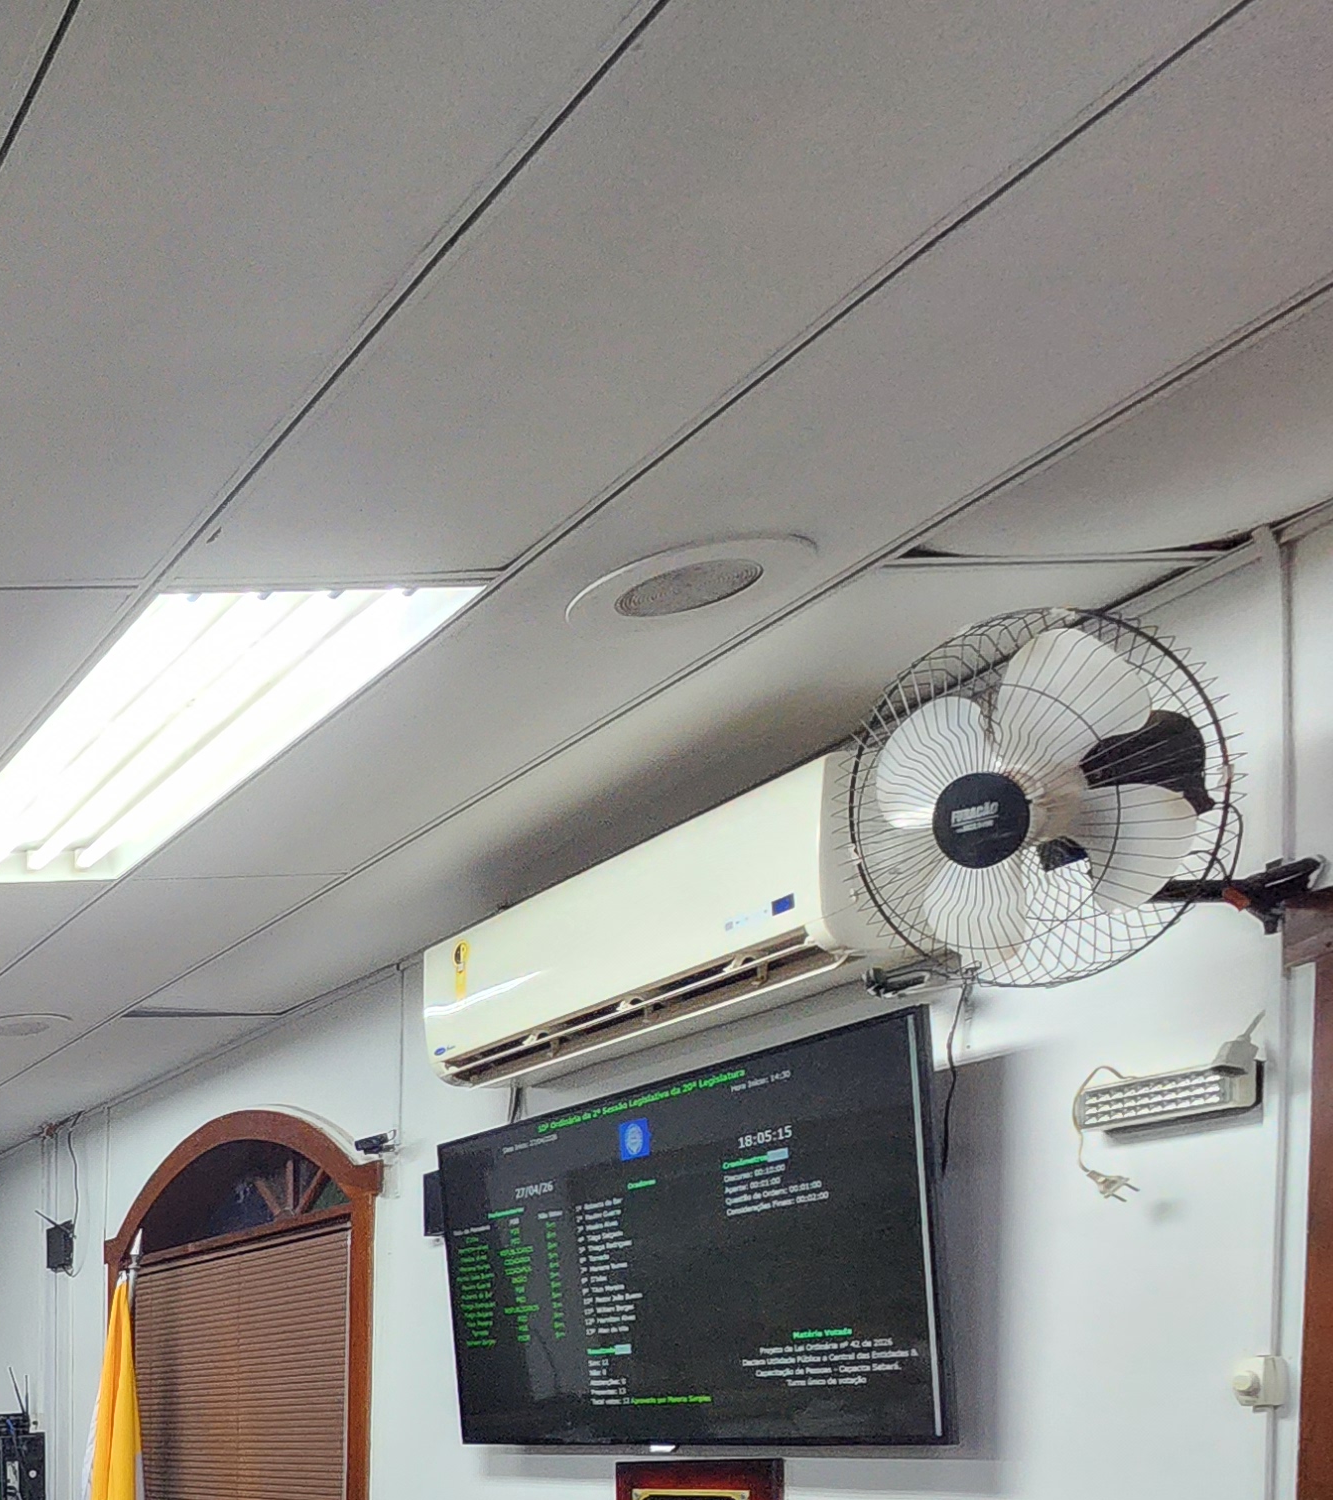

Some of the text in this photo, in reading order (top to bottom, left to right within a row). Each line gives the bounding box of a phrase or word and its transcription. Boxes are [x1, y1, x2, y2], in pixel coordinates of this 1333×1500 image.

[699, 1068, 745, 1088] Legislatura
[738, 1125, 792, 1148] 18:05:15
[515, 1180, 553, 1199] 27/04/26
